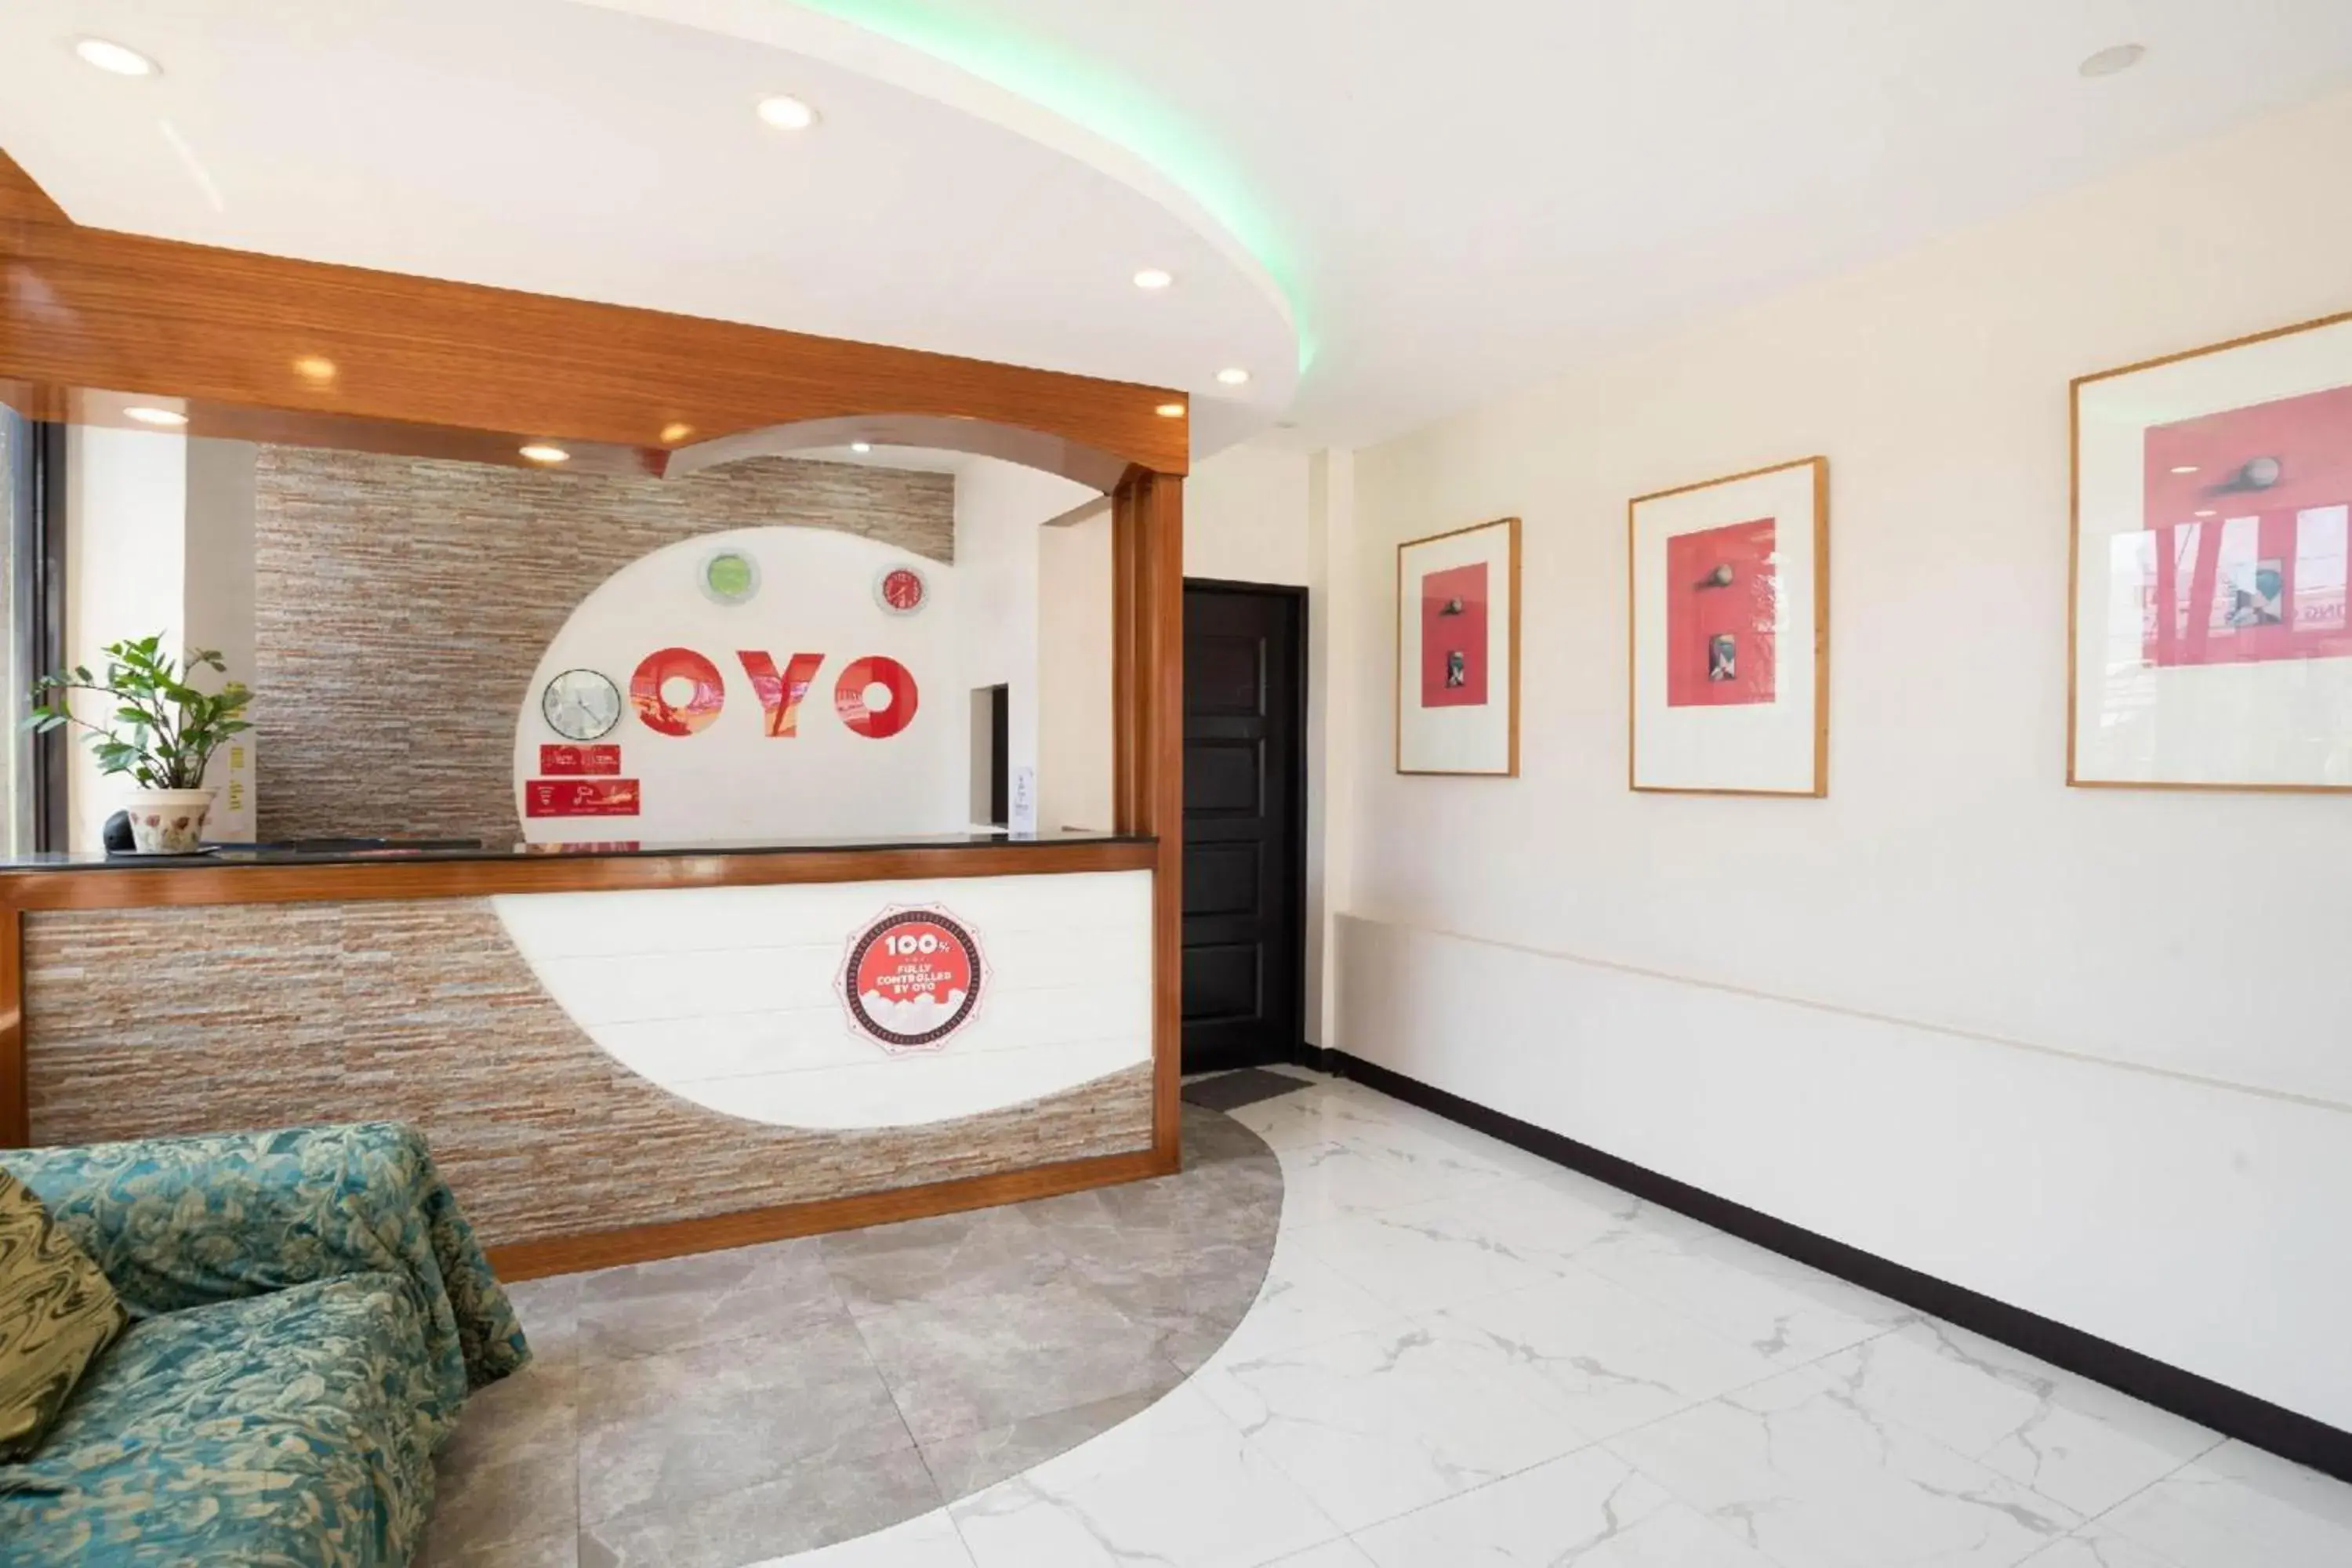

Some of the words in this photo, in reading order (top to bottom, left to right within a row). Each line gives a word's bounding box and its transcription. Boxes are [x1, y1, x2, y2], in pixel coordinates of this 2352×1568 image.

[630, 647, 919, 739] OYO
[897, 964, 932, 975] FULLY
[876, 971, 952, 985] CONTROLLED
[894, 984, 909, 994] BY
[912, 982, 935, 993] OYO
